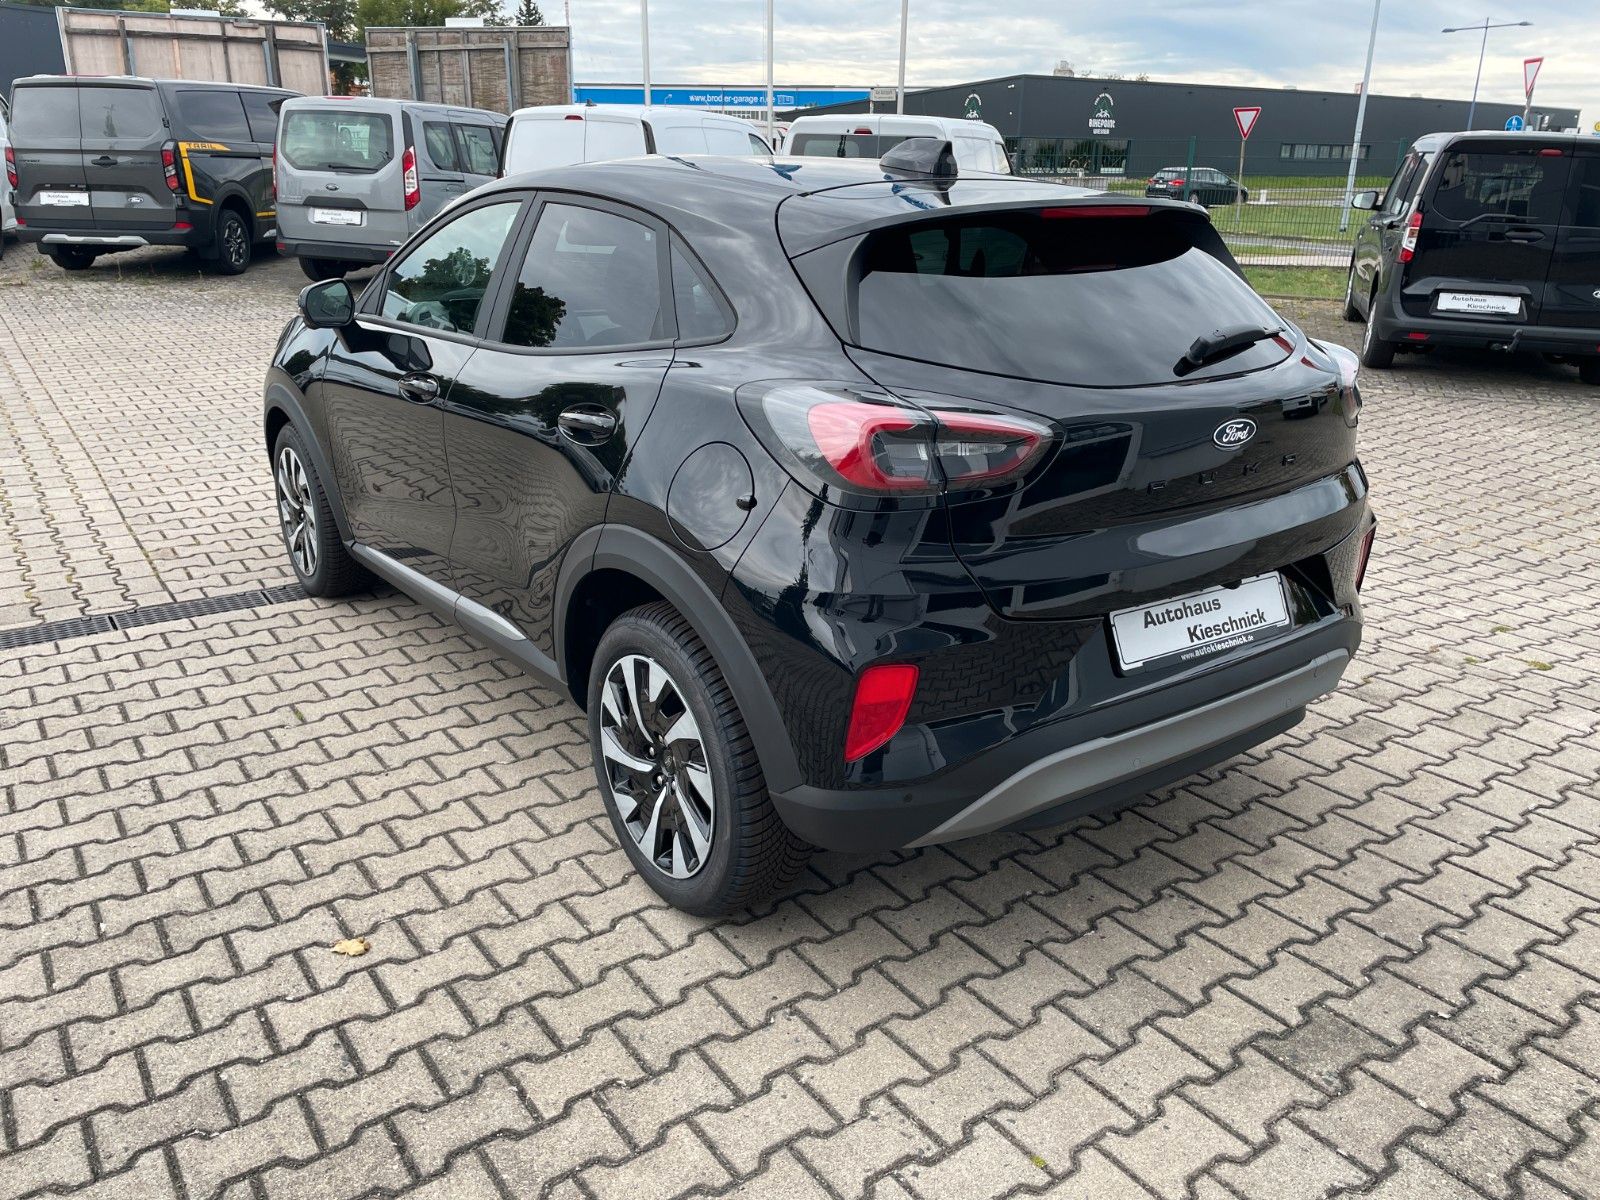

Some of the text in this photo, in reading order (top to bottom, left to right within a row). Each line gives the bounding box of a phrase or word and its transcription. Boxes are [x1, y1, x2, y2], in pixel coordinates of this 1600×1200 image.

[186, 142, 216, 150] TRAIL
[1451, 294, 1487, 303] Autohaus
[1467, 303, 1506, 311] Kieschnick
[1222, 423, 1250, 443] Ford
[1143, 598, 1222, 629] Autohaus
[1186, 608, 1267, 643] Kieschnick
[1180, 634, 1254, 660] www.autokieschnick.de
